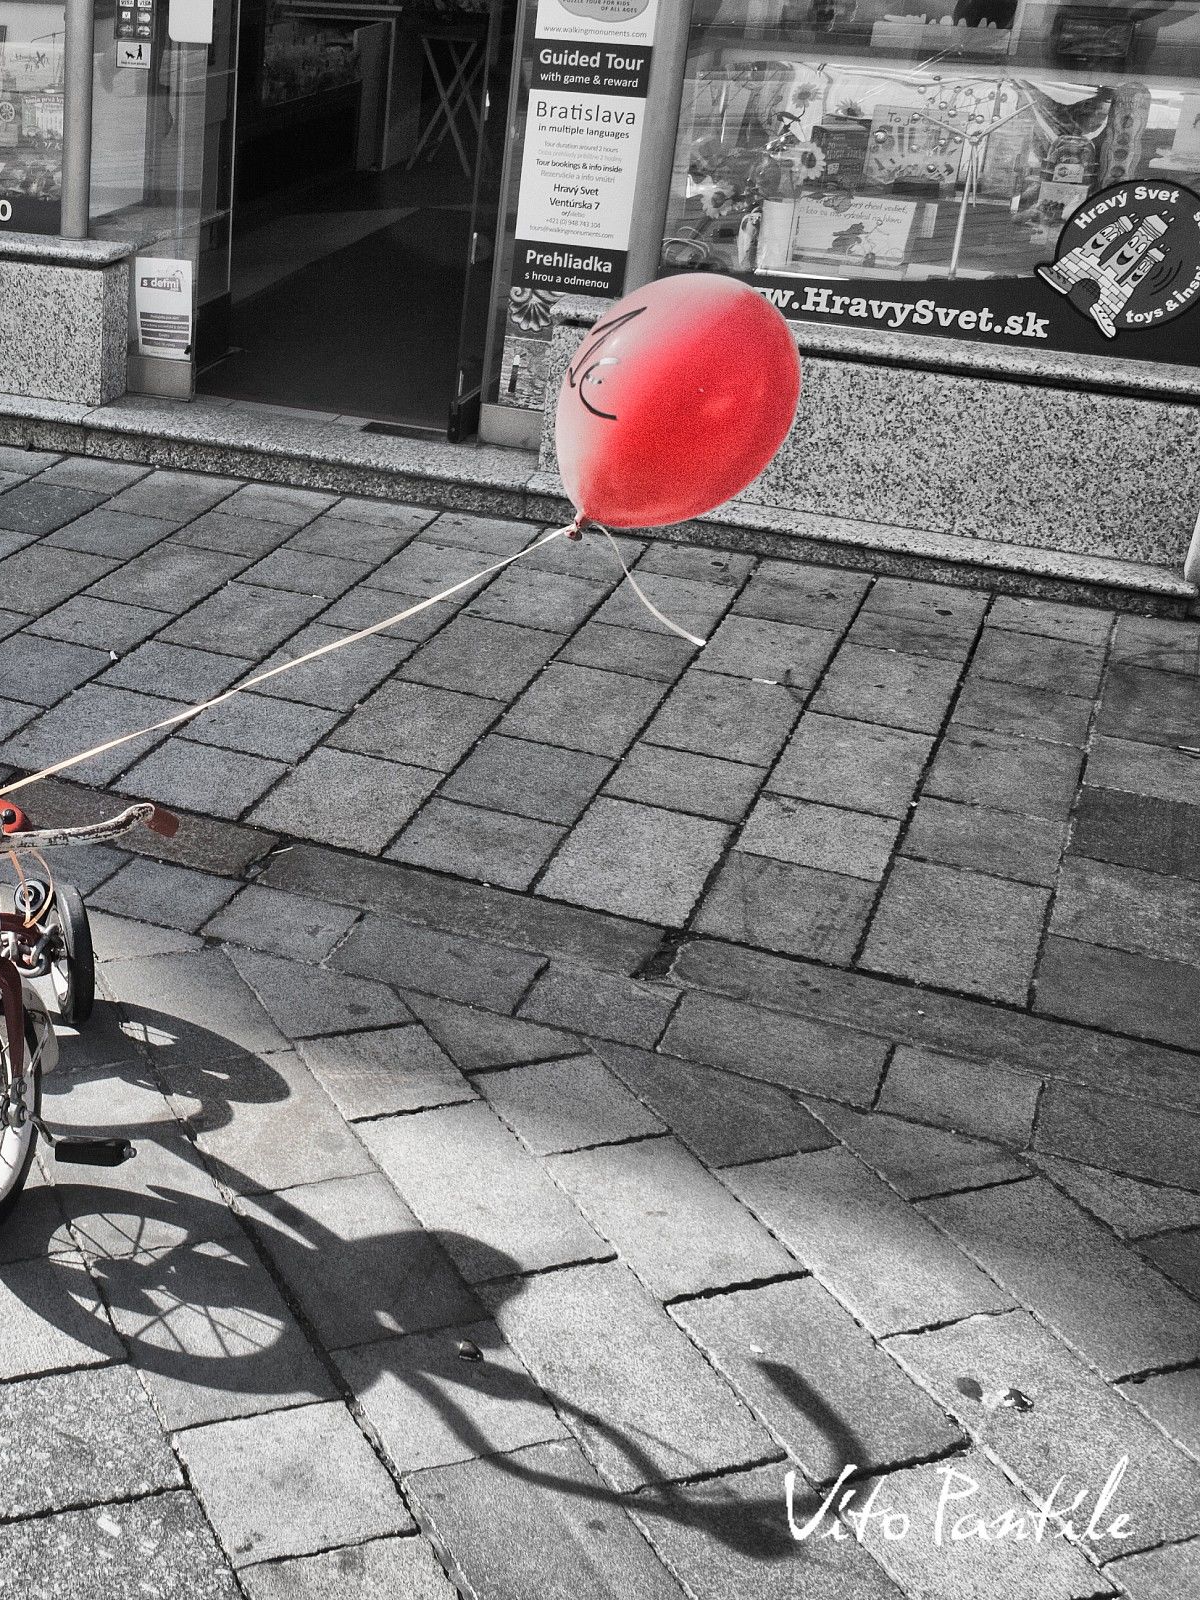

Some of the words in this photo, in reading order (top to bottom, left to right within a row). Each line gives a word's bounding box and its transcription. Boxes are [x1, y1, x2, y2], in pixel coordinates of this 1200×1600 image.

[543, 25, 647, 38] www.walkingmonuments.com
[539, 49, 601, 68] Guided
[605, 53, 644, 71] Tour
[540, 72, 561, 82] with
[563, 75, 590, 85] game
[592, 75, 601, 85] &
[603, 77, 638, 88] reward
[536, 100, 636, 125] Bratislava
[538, 123, 548, 131] in
[549, 124, 584, 136] multiple
[586, 128, 630, 140] languages
[535, 158, 550, 167] Tour
[551, 159, 581, 170] bookings
[581, 162, 588, 170] &
[588, 163, 602, 172] info
[602, 164, 623, 173] inside
[553, 183, 579, 196] Hravý
[580, 186, 599, 197] Svet
[549, 197, 593, 210] Ventúrska
[594, 201, 600, 210] 7
[1073, 190, 1128, 230] Hravý
[1134, 186, 1180, 204] Svet
[525, 249, 612, 273] Prehliadka
[524, 272, 530, 280] s
[532, 271, 554, 282] hrou
[555, 275, 562, 283] a
[563, 276, 609, 289] odmenou
[753, 286, 1050, 339] w.HravySvet.sk
[1125, 307, 1164, 324] toys
[1165, 299, 1180, 312] &
